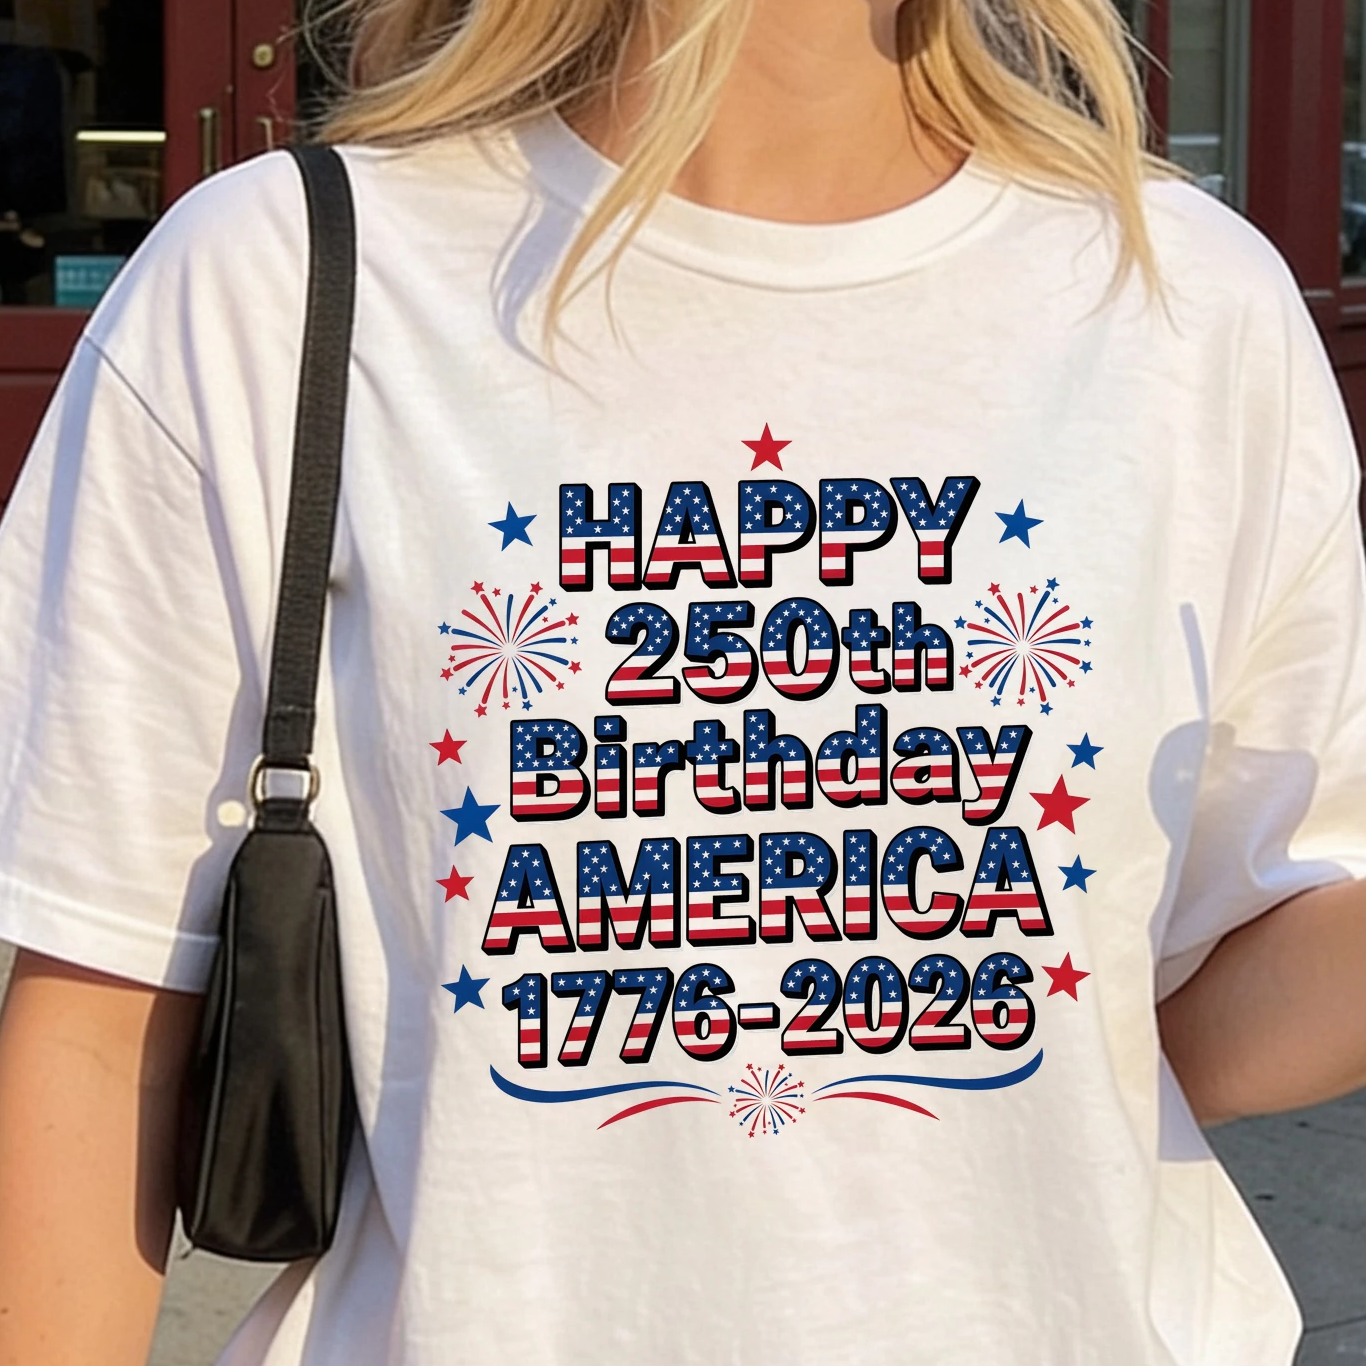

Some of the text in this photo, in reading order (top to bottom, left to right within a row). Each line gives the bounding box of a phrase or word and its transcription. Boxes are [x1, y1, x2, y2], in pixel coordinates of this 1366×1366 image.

[558, 475, 981, 593] HAPPY
[604, 596, 955, 707] 250th
[509, 703, 1033, 827] Birthday
[481, 825, 1055, 956] AMERICA
[501, 951, 1036, 1069] 1776-2026
